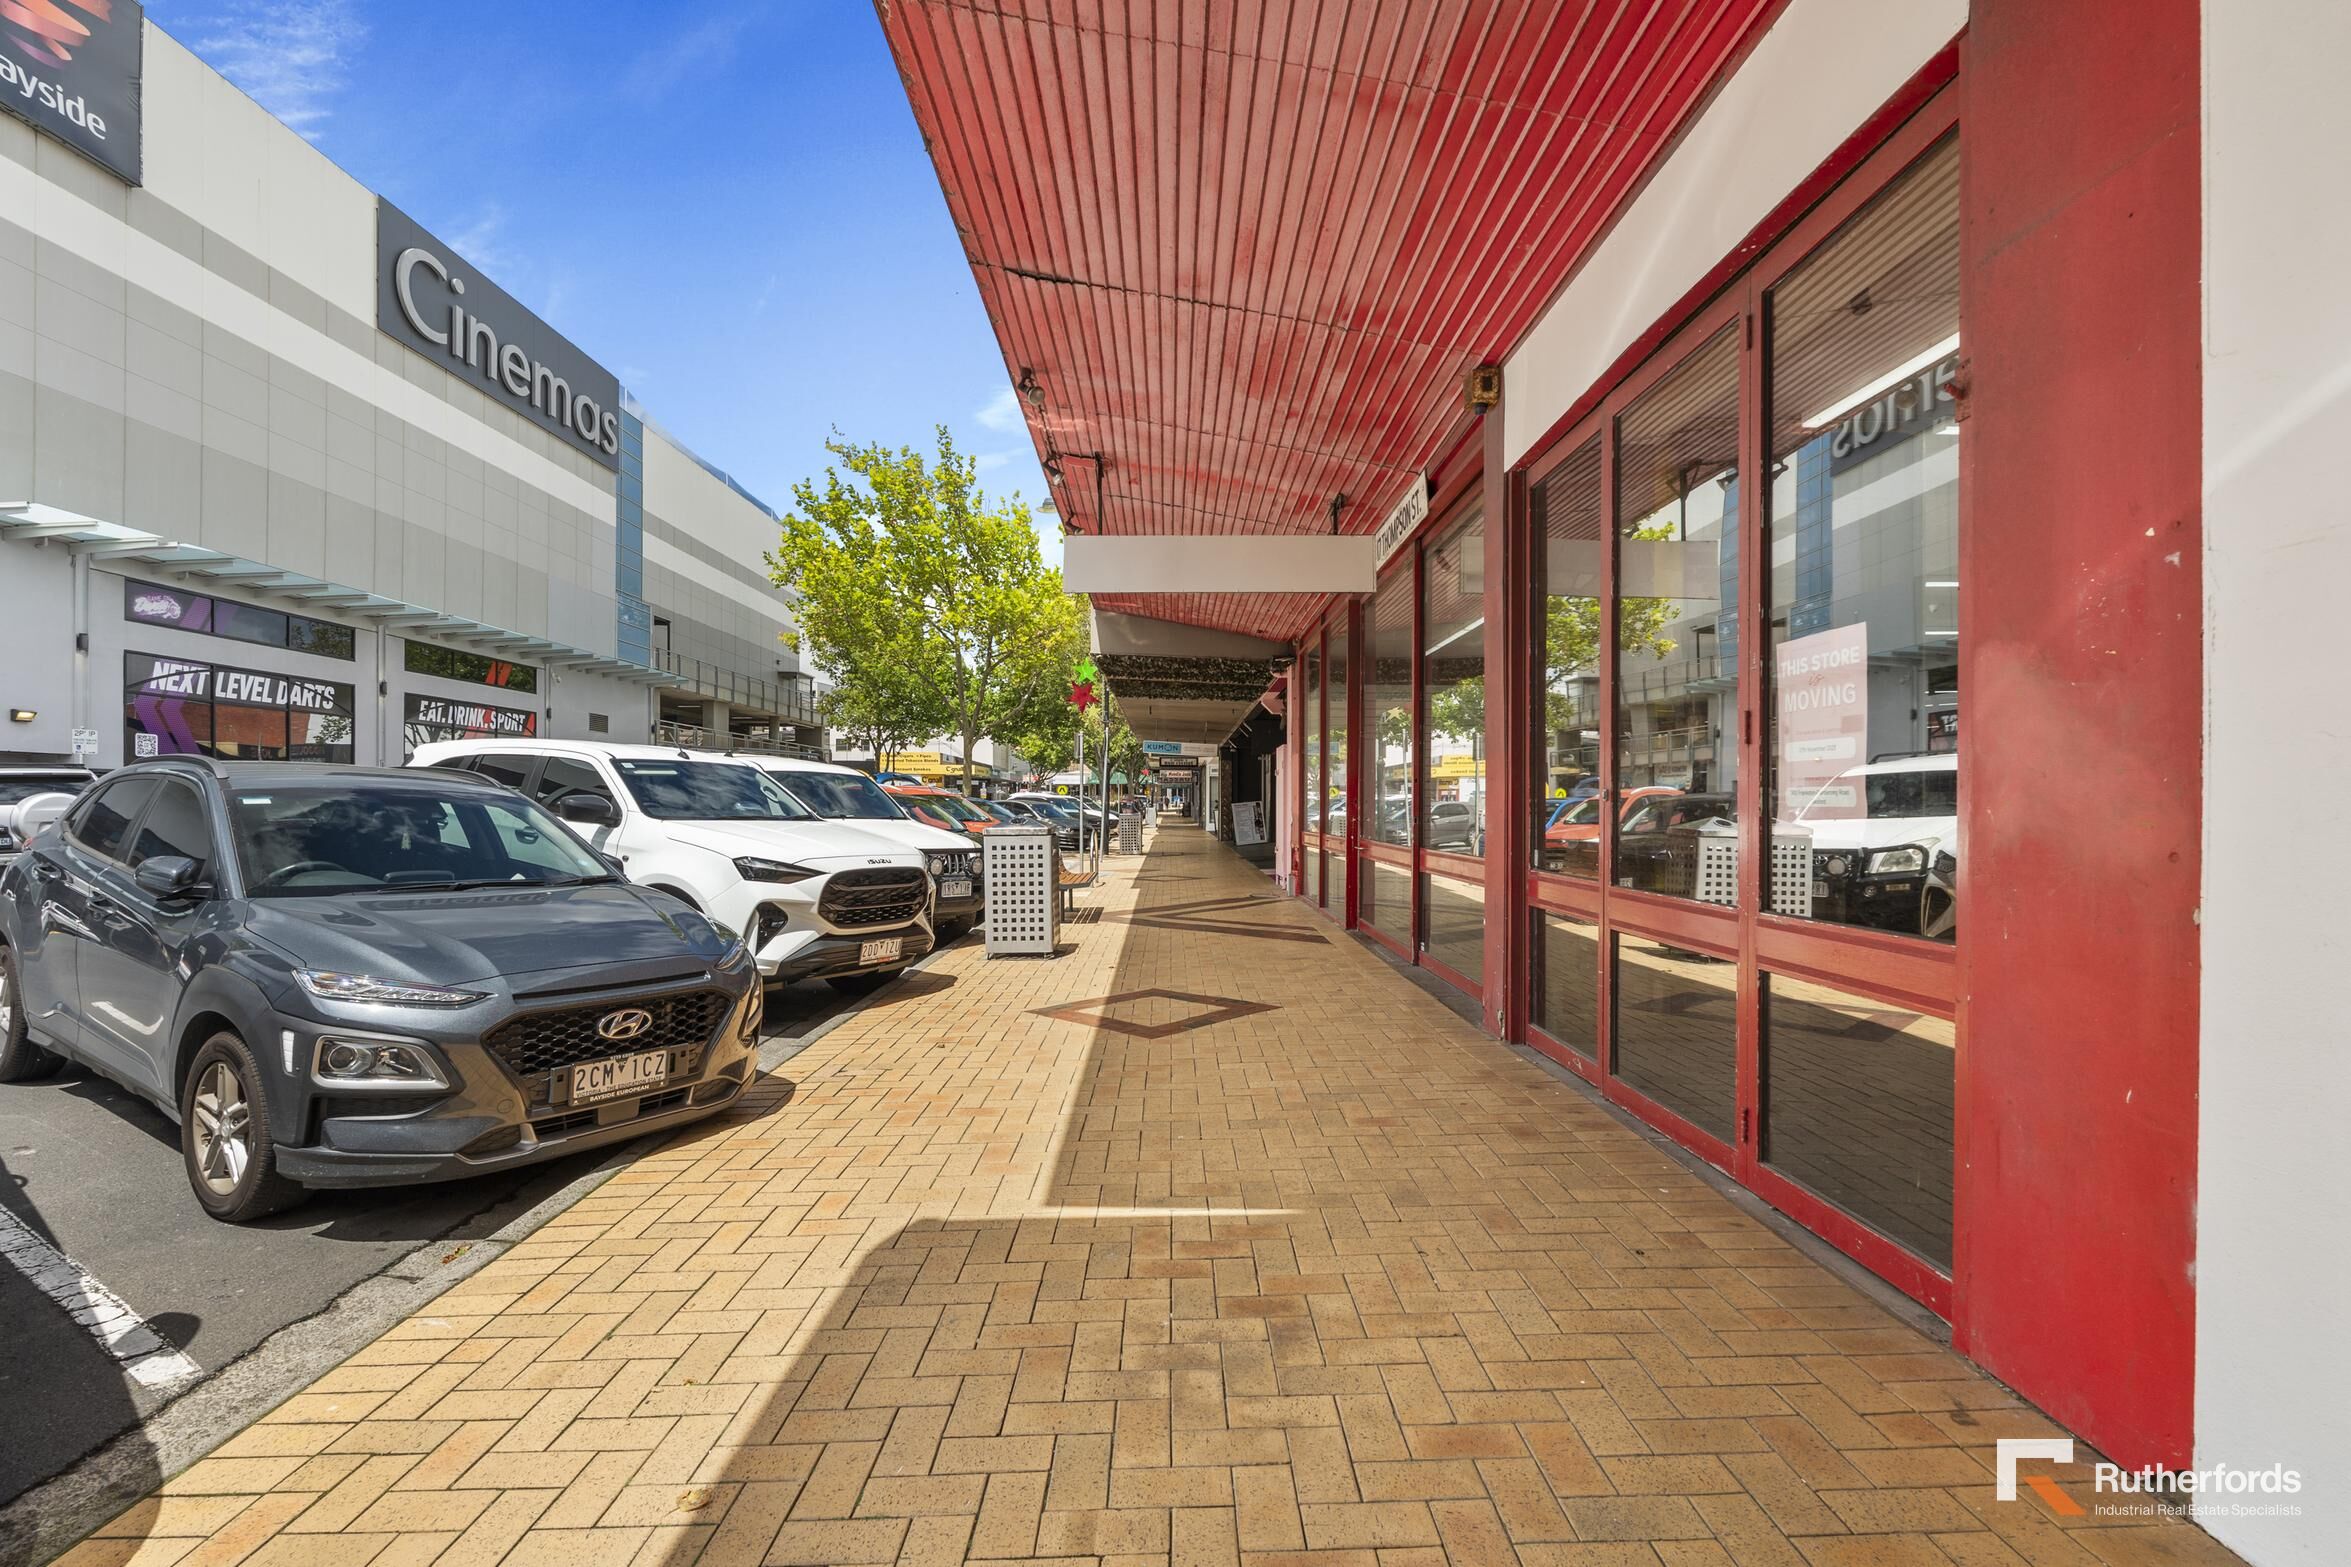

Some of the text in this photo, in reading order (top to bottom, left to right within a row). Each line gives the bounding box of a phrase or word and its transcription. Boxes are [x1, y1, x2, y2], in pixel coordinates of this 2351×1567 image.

[395, 247, 618, 456] Cinemas
[1382, 500, 1412, 557] THOMPSON
[1411, 488, 1422, 520] ST.
[1780, 646, 1860, 679] THIS STORE
[150, 661, 335, 710] NEXT LEVEL DARTS
[1808, 673, 1824, 687] is
[1784, 683, 1856, 713] MOVING
[418, 699, 526, 732] EAT. DRINK. SPORT
[1147, 743, 1179, 752] KUMON
[576, 1053, 664, 1091] 2CM 1CZ
[590, 1084, 650, 1101] BAYSIDE EUROPEAN
